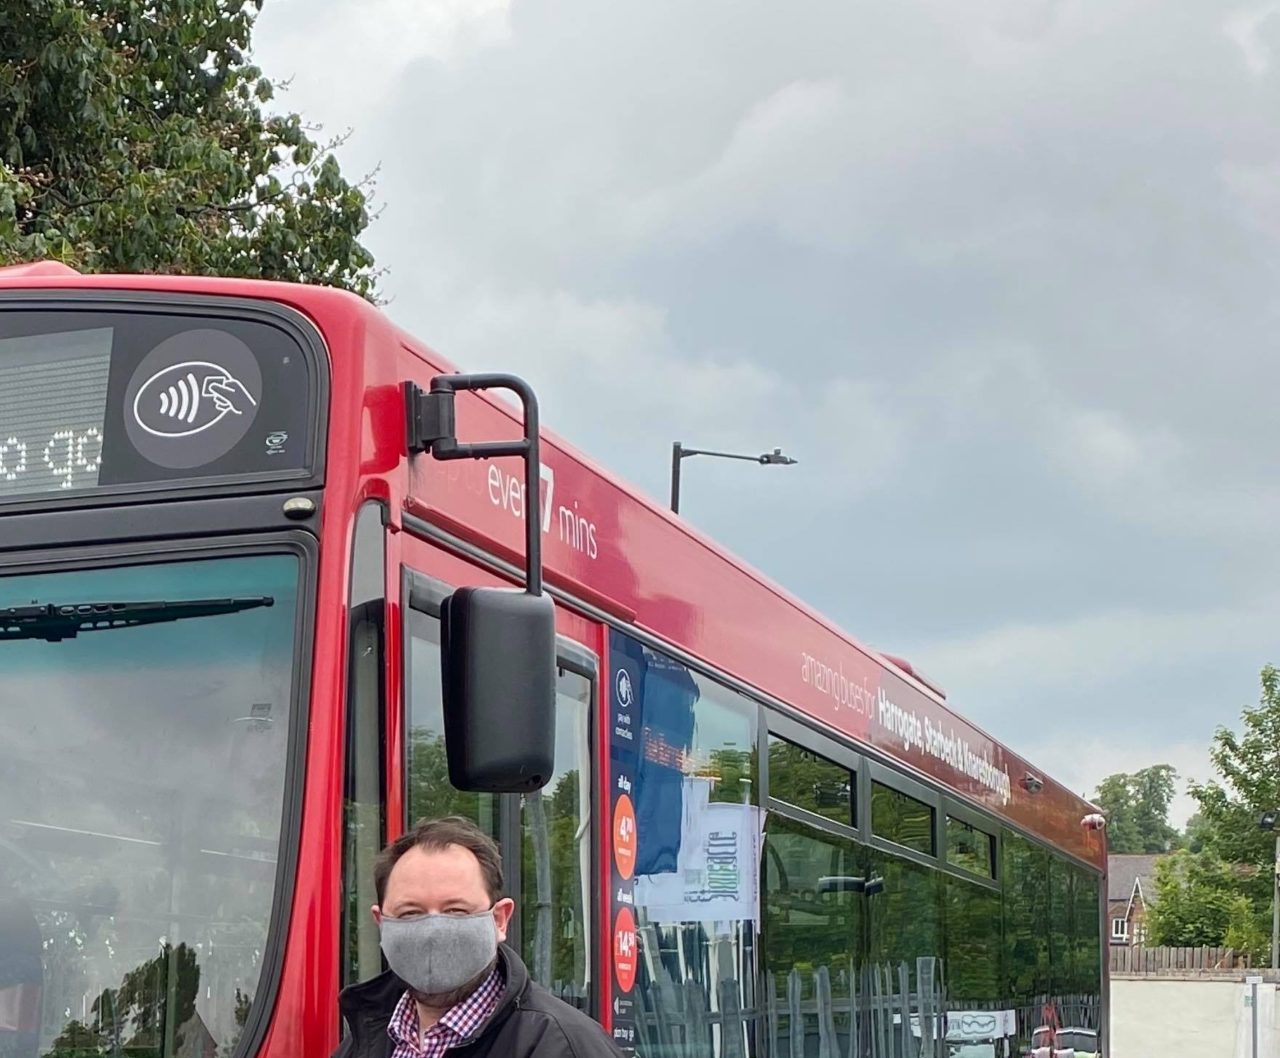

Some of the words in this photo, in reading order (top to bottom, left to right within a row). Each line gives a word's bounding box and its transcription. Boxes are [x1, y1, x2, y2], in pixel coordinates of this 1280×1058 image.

[42, 426, 103, 489] go
[539, 462, 554, 533] 7
[558, 501, 598, 560] mins
[801, 652, 839, 711] amazing
[839, 660, 864, 715] buses
[877, 686, 925, 755] Harrogate,
